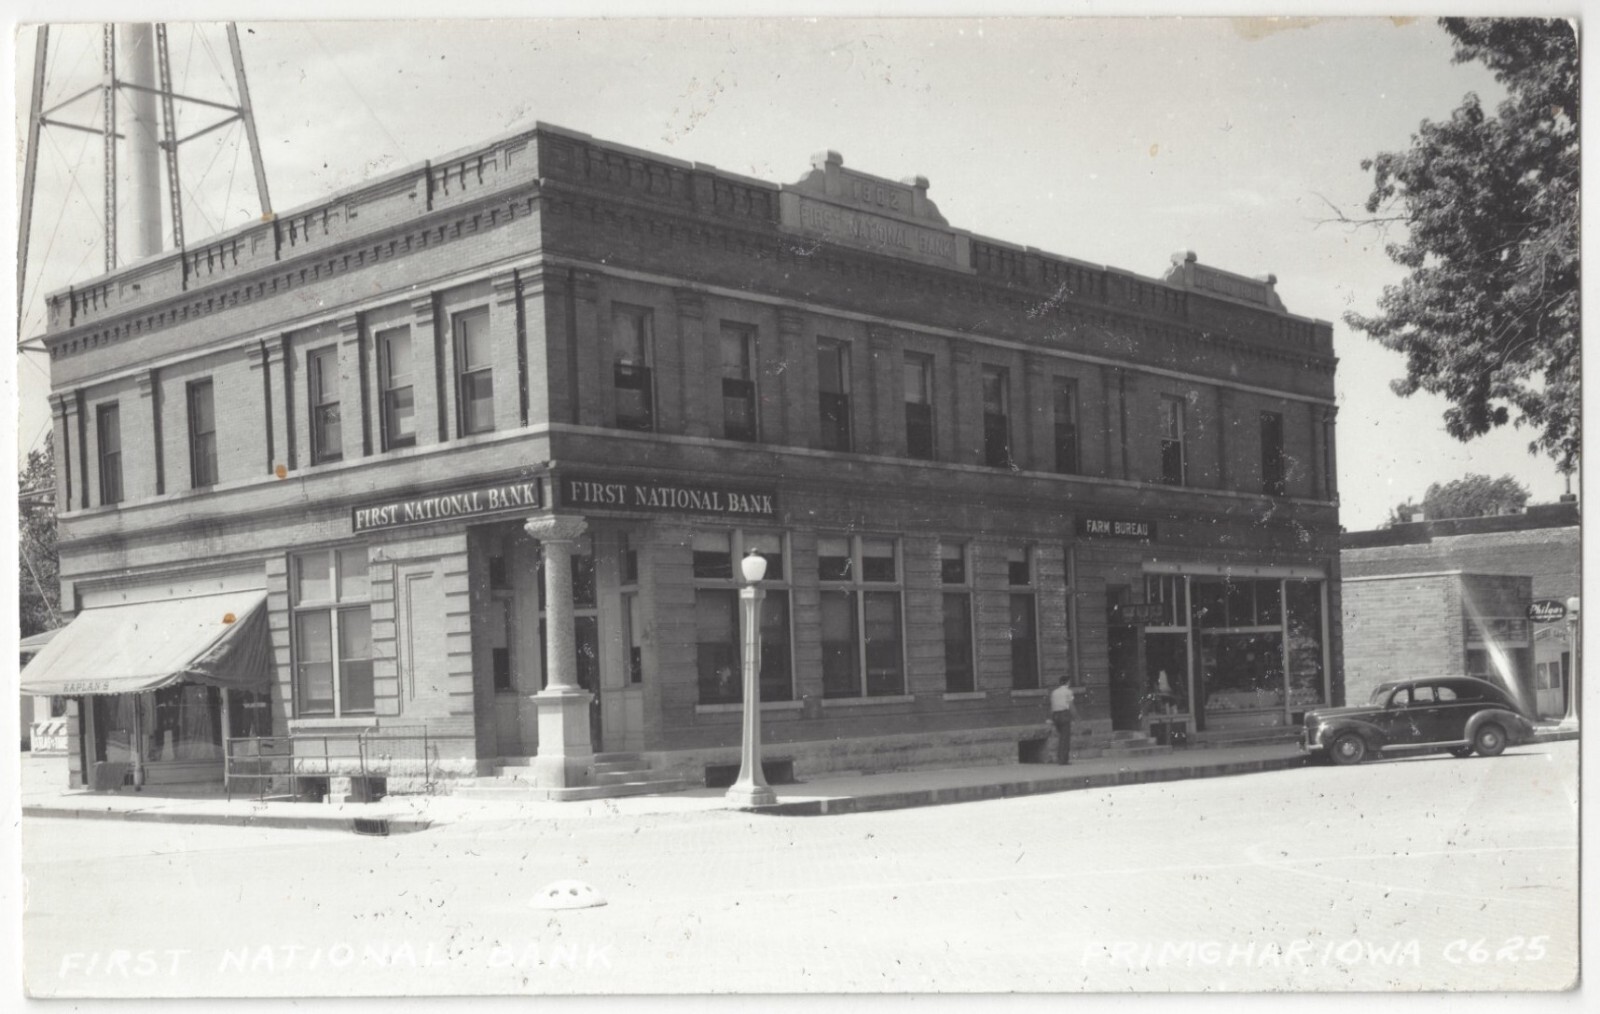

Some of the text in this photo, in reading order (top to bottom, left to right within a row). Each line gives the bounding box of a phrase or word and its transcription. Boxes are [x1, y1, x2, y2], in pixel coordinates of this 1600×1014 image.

[801, 205, 952, 257] FIRST NATIONAL BANK
[356, 482, 535, 529] FIRST NATIONAL BANK
[570, 481, 773, 514] FIRST NATIONAL BANK
[1086, 519, 1148, 536] FARM BUREAU
